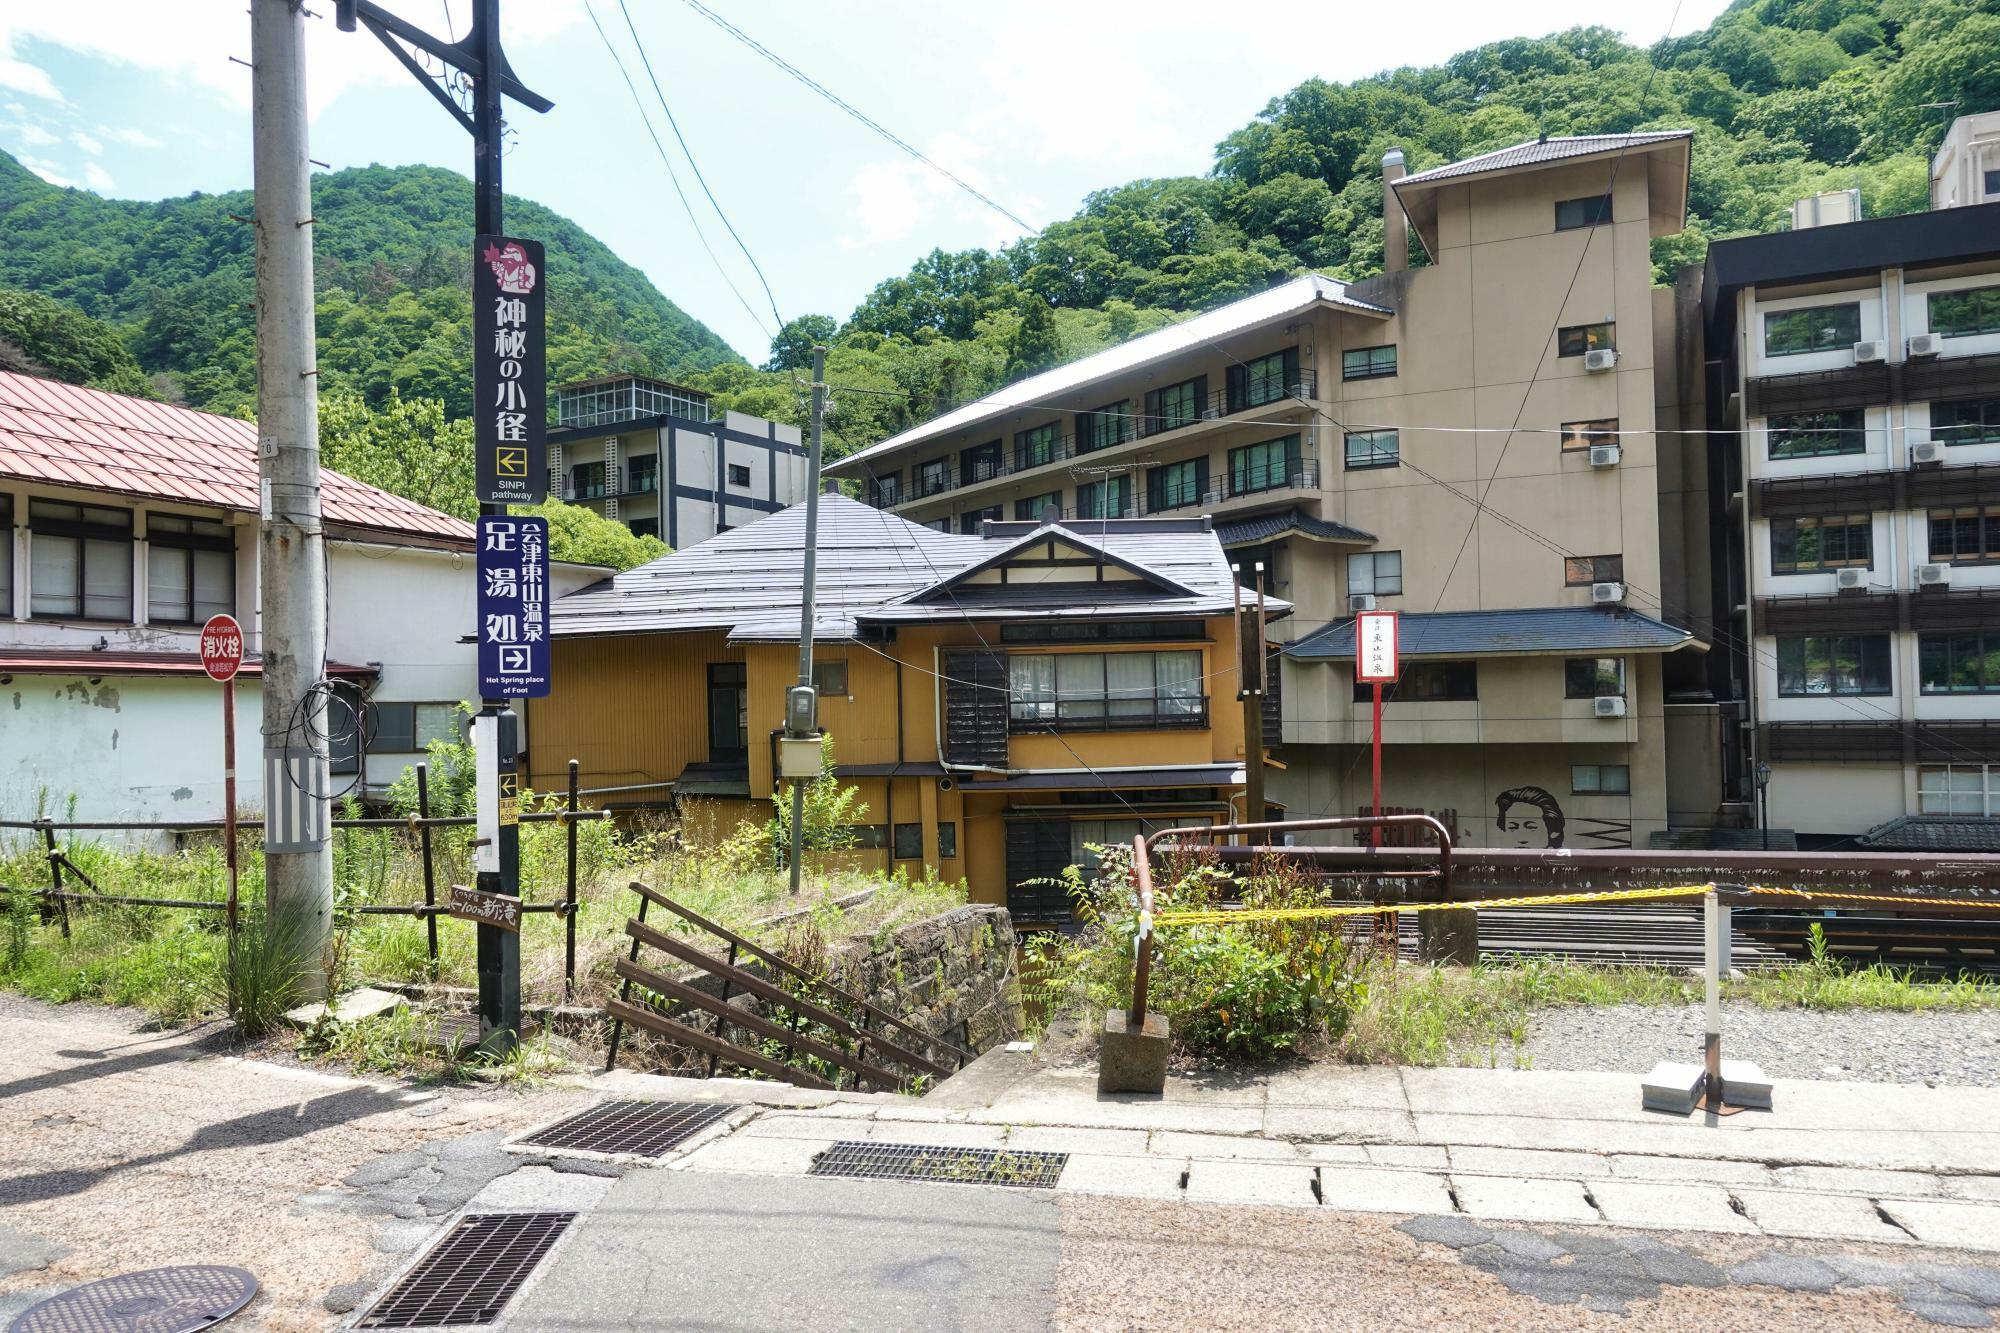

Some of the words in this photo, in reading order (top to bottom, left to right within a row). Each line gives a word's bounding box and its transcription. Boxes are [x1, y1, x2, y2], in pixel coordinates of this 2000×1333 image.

[494, 296, 527, 441] 神秘の小径
[491, 490, 532, 501] pathway
[498, 480, 525, 490] SINPI
[485, 521, 518, 643] 足湯処
[521, 523, 543, 642] 会津東山温泉
[204, 635, 239, 658] 消火栓
[486, 676, 499, 684] Hot
[500, 676, 524, 686] Spring
[525, 676, 545, 685] place
